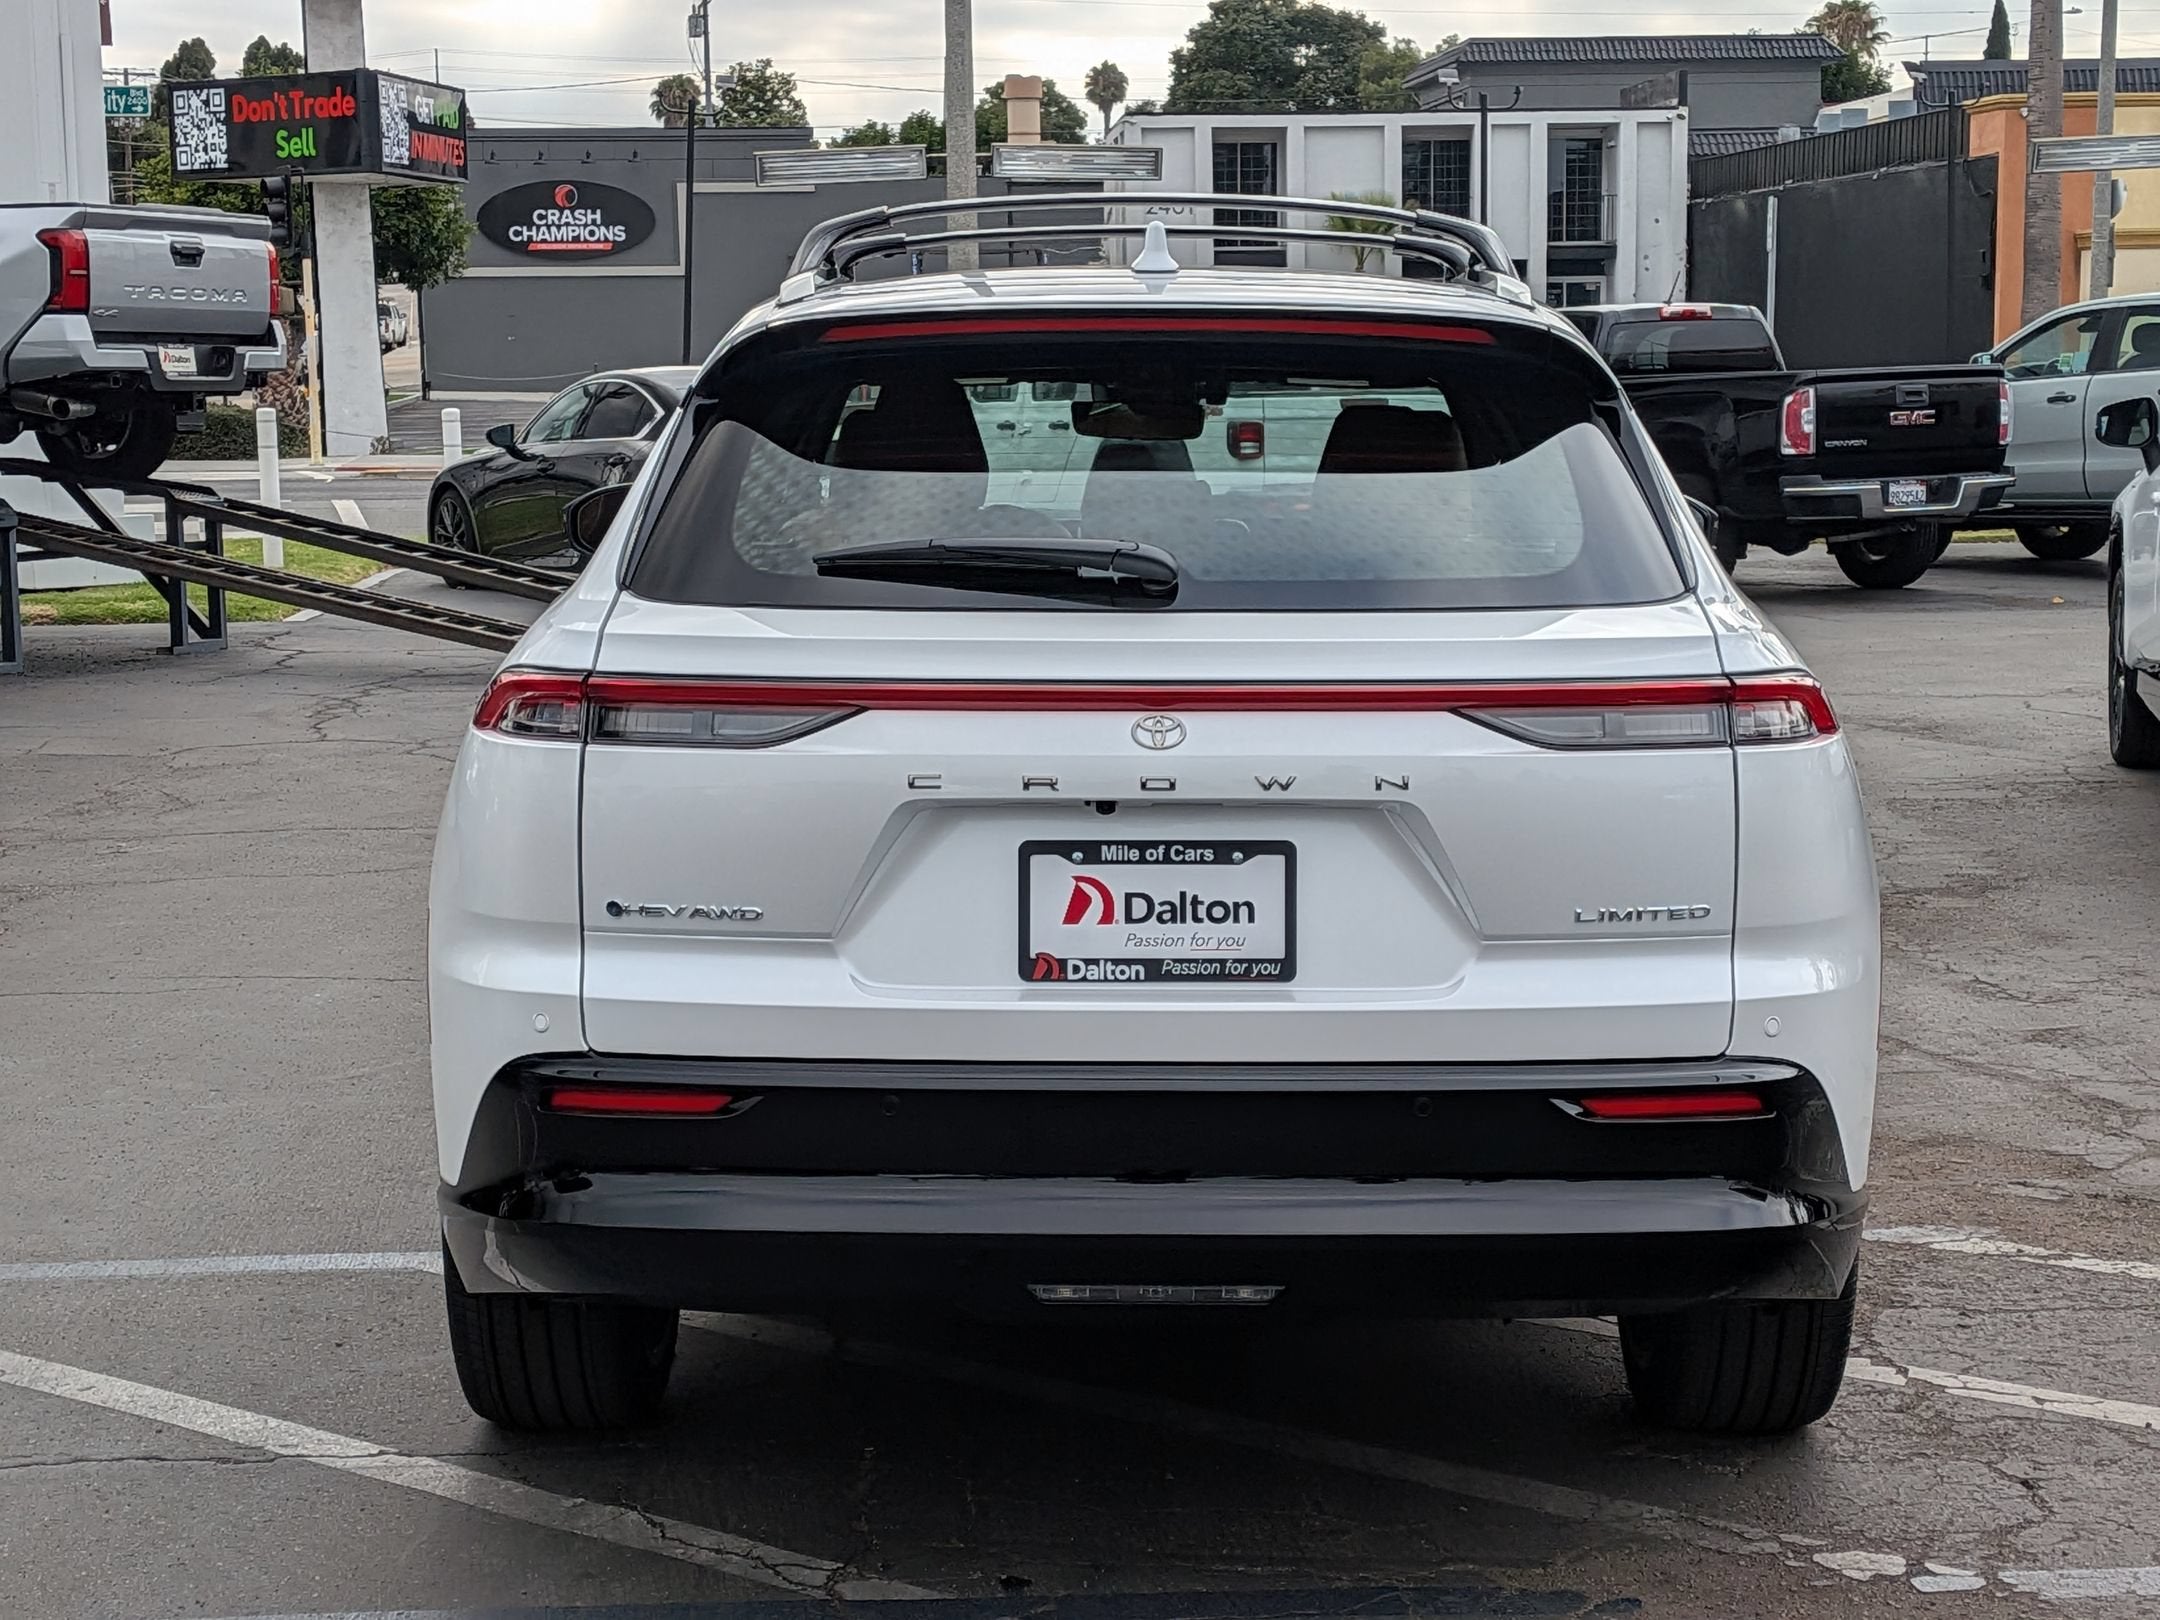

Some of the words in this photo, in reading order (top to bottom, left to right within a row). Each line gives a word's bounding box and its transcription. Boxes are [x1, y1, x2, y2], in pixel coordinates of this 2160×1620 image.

[104, 89, 126, 113] ity
[232, 91, 288, 122] Don't
[288, 86, 356, 119] Trade
[415, 95, 434, 125] GET
[276, 128, 317, 159] Sell
[411, 129, 423, 159] IN
[423, 132, 464, 167] MINUTES
[532, 209, 601, 225] CRASH
[508, 225, 626, 242] CHAMPIONS
[124, 284, 248, 303] TACOMA
[1889, 410, 1935, 426] GMC
[907, 773, 1410, 791] CROWN
[1101, 845, 1139, 862] Mile
[1145, 845, 1165, 862] of
[1170, 845, 1215, 862] Cars
[689, 905, 764, 921] AWD
[1124, 890, 1255, 925] Dalton
[1575, 903, 1711, 923] LIMITED
[1124, 933, 1185, 948] Passion
[1190, 933, 1213, 949] for
[1215, 936, 1246, 949] you
[1067, 959, 1145, 980] Dalton
[1161, 959, 1221, 975] Passion
[1225, 960, 1248, 976] for
[1250, 963, 1281, 977] you
